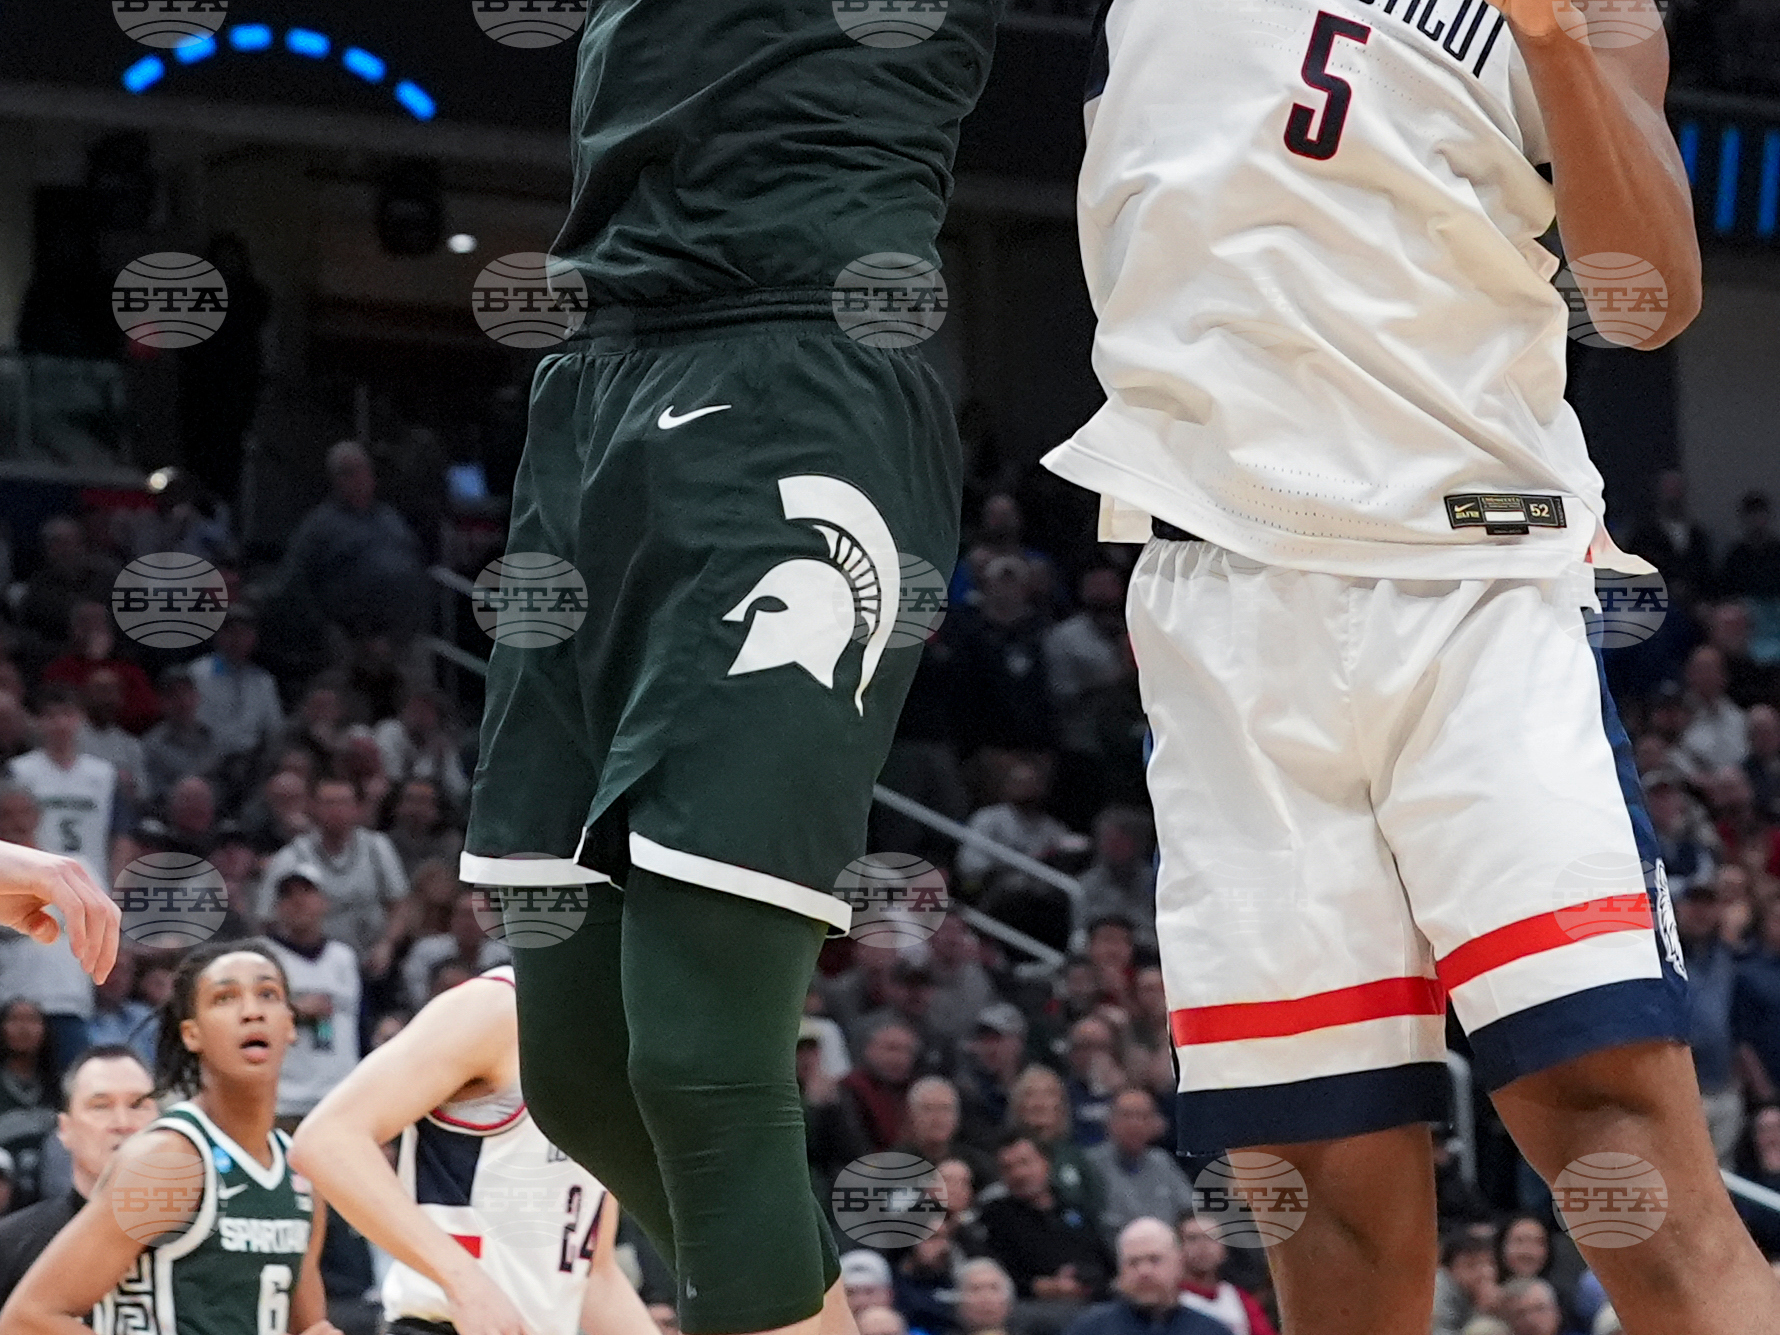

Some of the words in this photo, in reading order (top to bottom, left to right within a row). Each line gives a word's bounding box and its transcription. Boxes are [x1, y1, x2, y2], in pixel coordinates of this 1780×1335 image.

[1283, 10, 1372, 161] 5
[1529, 503, 1551, 518] 52
[257, 1263, 293, 1335] 6
